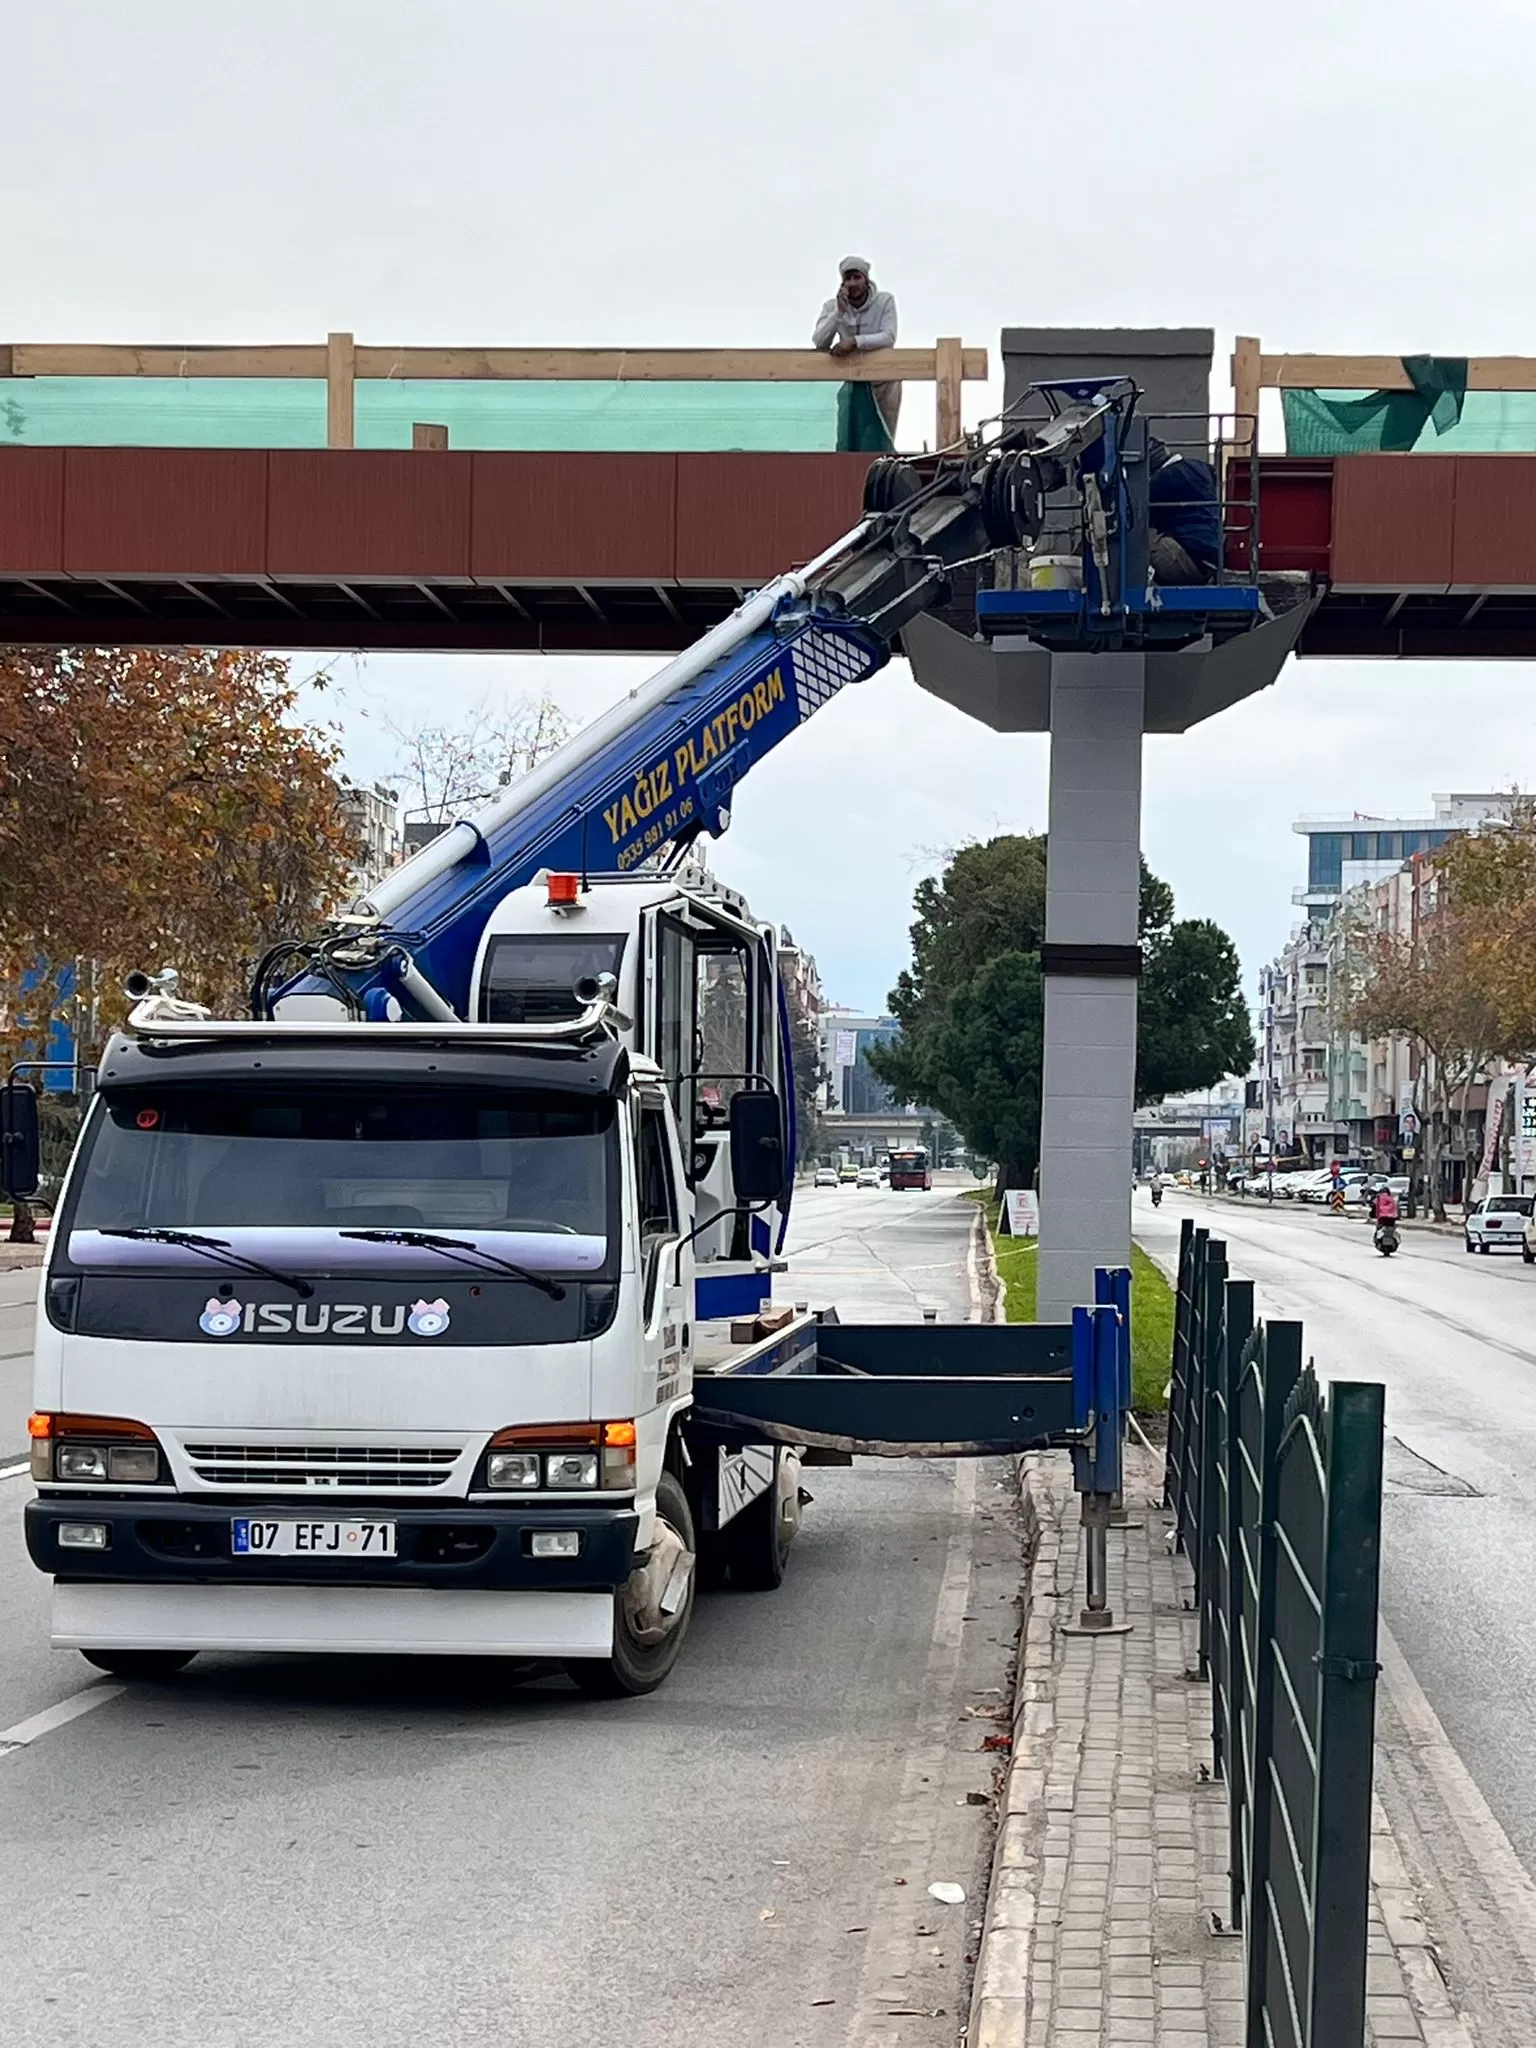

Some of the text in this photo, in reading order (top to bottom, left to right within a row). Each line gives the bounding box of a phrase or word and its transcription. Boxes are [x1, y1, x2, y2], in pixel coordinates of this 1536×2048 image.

[603, 667, 786, 844] YAĞIZ PLATFORM
[664, 808, 678, 832] 91
[680, 796, 693, 818] 06
[243, 1303, 406, 1335] ISUZU
[251, 1523, 388, 1551] 07 EFJ 71
